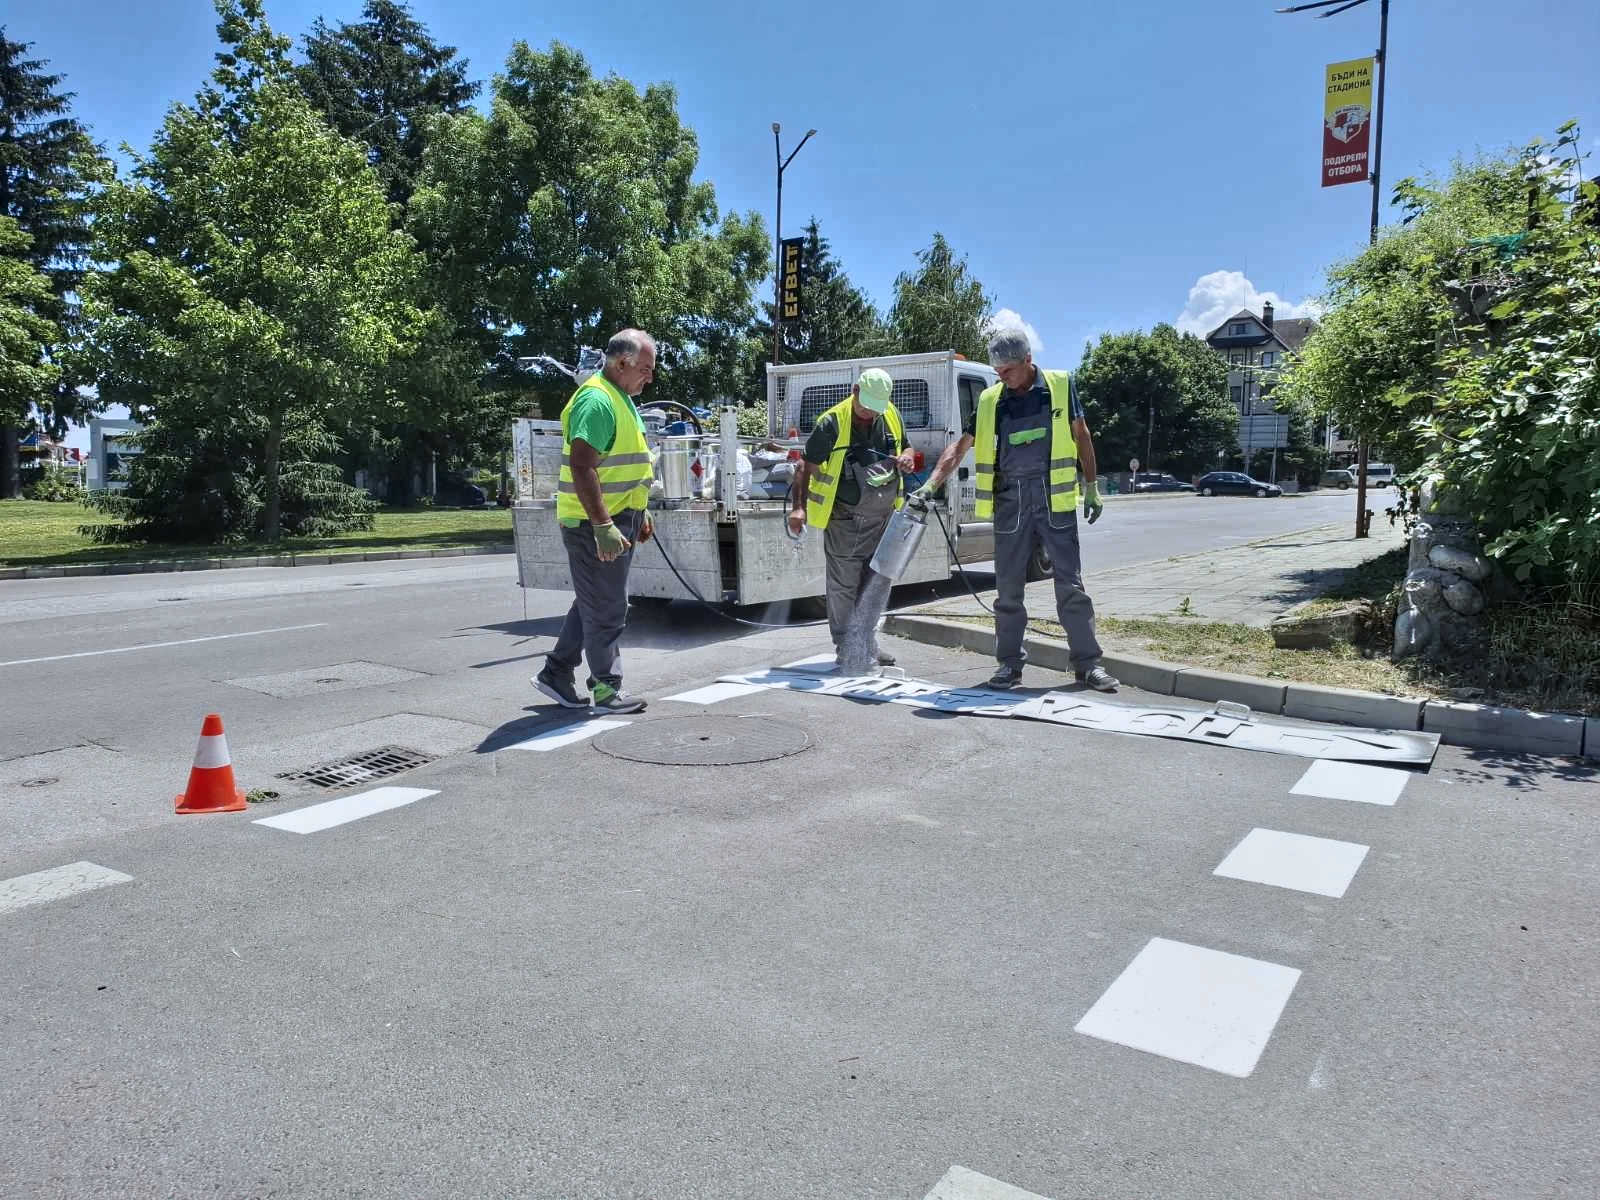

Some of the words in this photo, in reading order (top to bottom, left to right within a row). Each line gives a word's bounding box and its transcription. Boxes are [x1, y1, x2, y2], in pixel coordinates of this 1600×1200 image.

[1331, 71, 1355, 82] БЪДИ
[1357, 67, 1368, 78] НА
[1328, 79, 1371, 94] СТАДИОНА
[1324, 151, 1367, 166] ПОДКРЕПИ
[1328, 163, 1362, 177] ОТБОРА
[785, 244, 798, 317] EFBET
